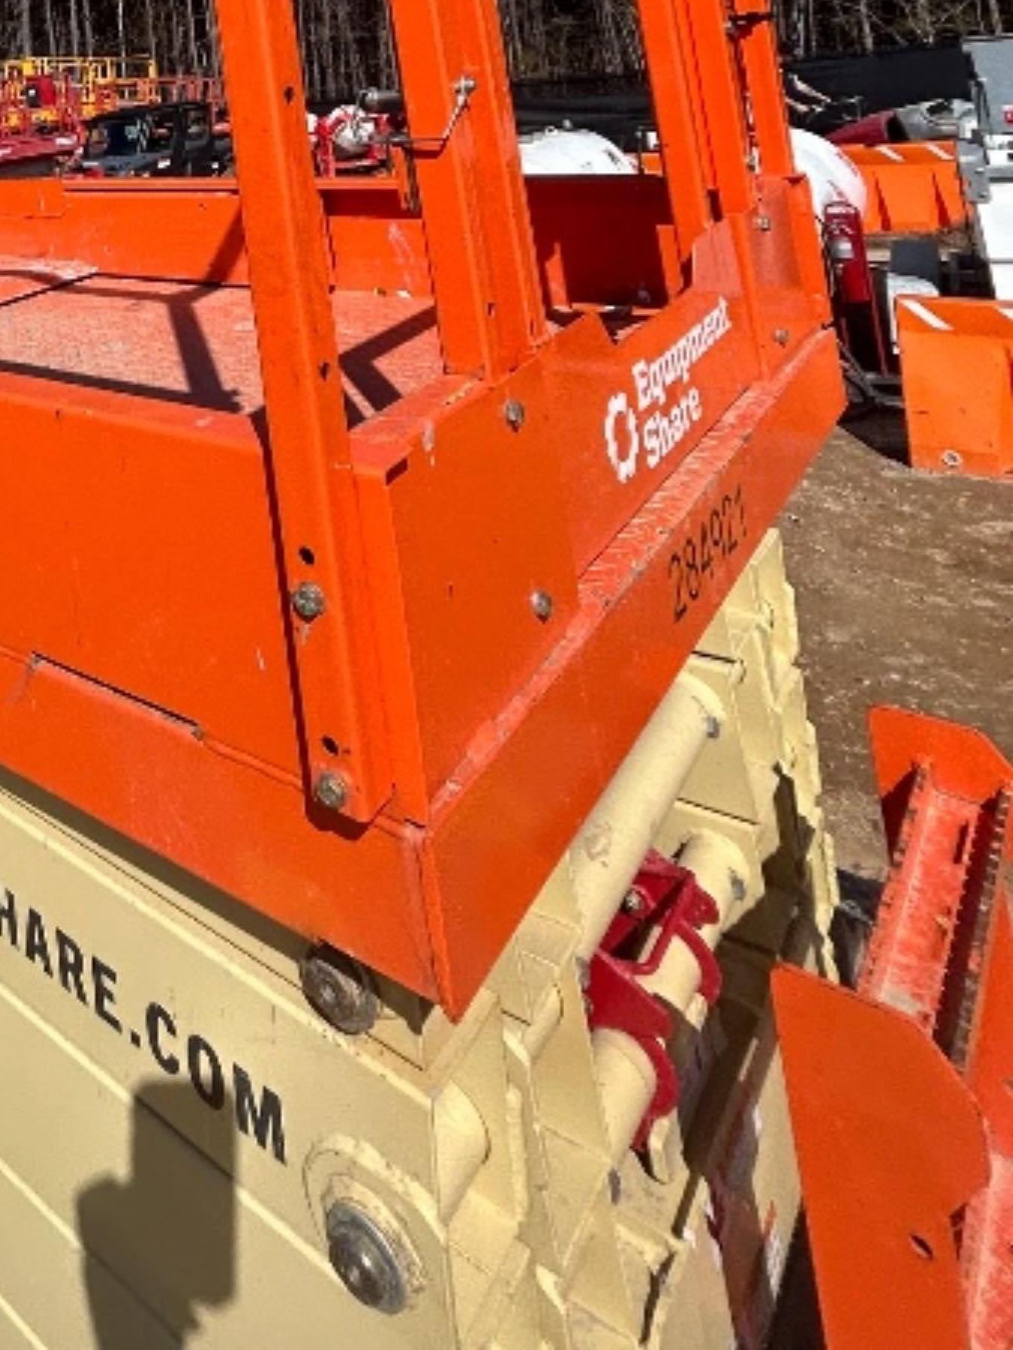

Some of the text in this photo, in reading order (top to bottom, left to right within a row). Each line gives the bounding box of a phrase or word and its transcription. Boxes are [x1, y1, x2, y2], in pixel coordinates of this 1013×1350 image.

[631, 295, 733, 412] Equipment
[643, 387, 704, 469] Share
[668, 482, 748, 624] 284921
